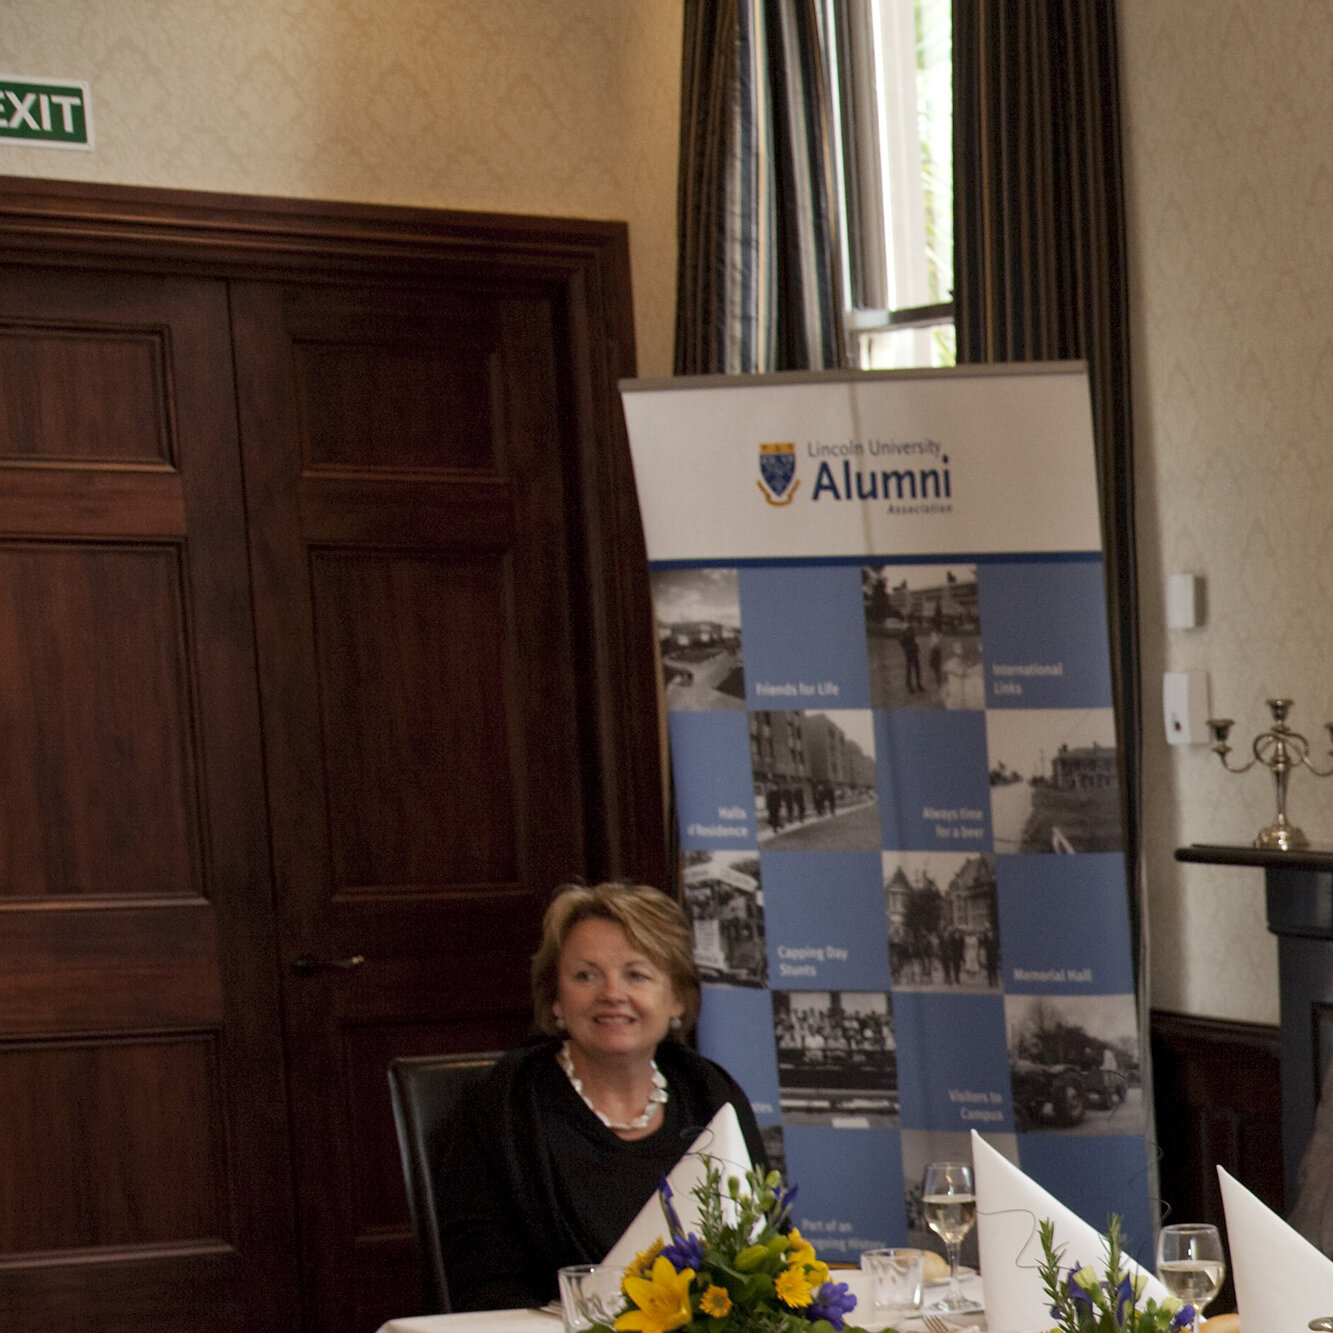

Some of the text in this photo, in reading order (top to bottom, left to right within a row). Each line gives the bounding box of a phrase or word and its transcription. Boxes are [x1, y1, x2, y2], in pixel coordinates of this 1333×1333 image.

[808, 437, 941, 458] Lincoln University
[812, 454, 952, 501] Alumni
[888, 503, 953, 515] Association
[992, 662, 1064, 678] International
[755, 681, 839, 697] Friends for Life
[994, 681, 1023, 696] Links
[777, 945, 848, 962] Capping Day
[1013, 968, 1093, 982] Memorial Hall
[948, 1088, 988, 1103] Visitors
[960, 1107, 1004, 1122] Campus
